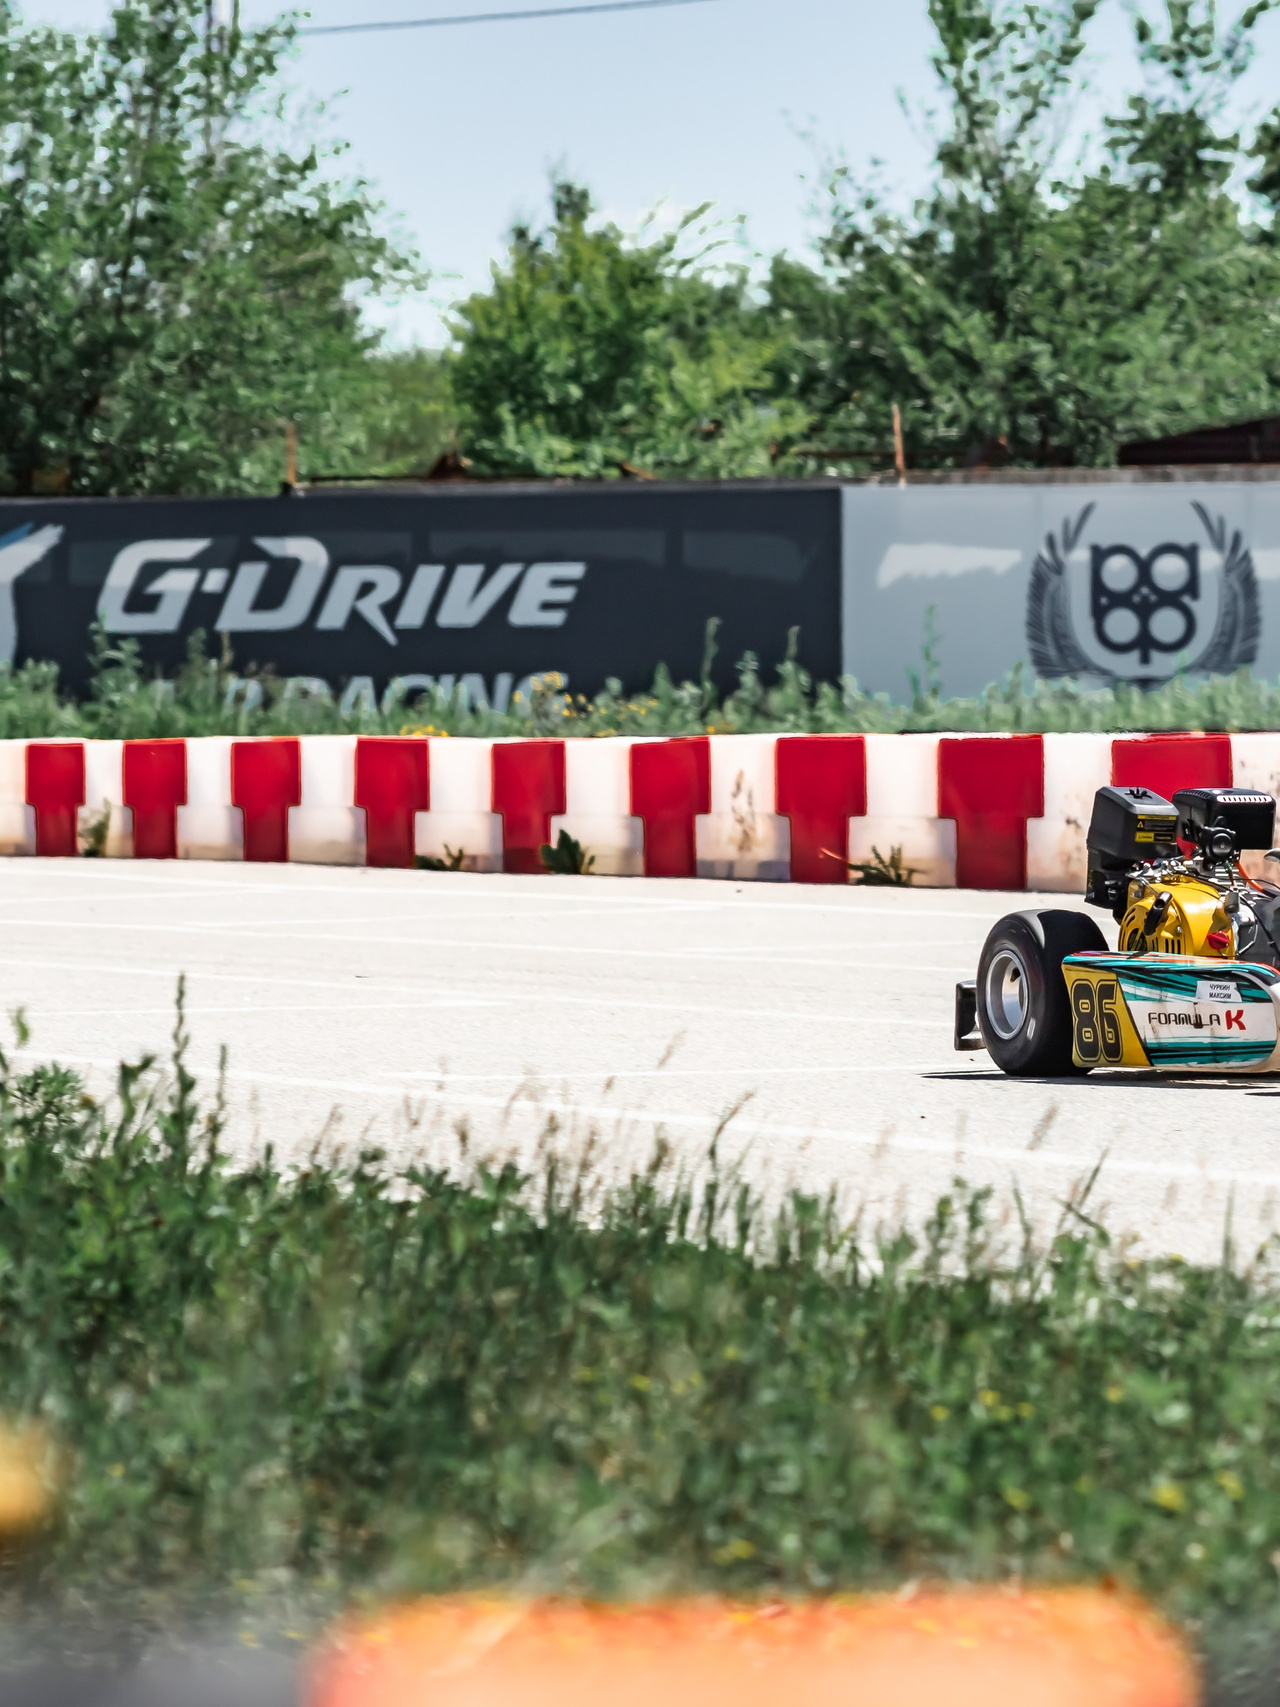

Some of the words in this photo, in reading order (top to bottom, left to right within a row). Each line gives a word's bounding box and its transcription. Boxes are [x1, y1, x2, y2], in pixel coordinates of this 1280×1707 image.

[1209, 992, 1232, 1000] МАКСИМ
[1070, 978, 1123, 1063] 86
[1148, 1012, 1221, 1027] FORMULA
[1225, 1009, 1247, 1030] K
